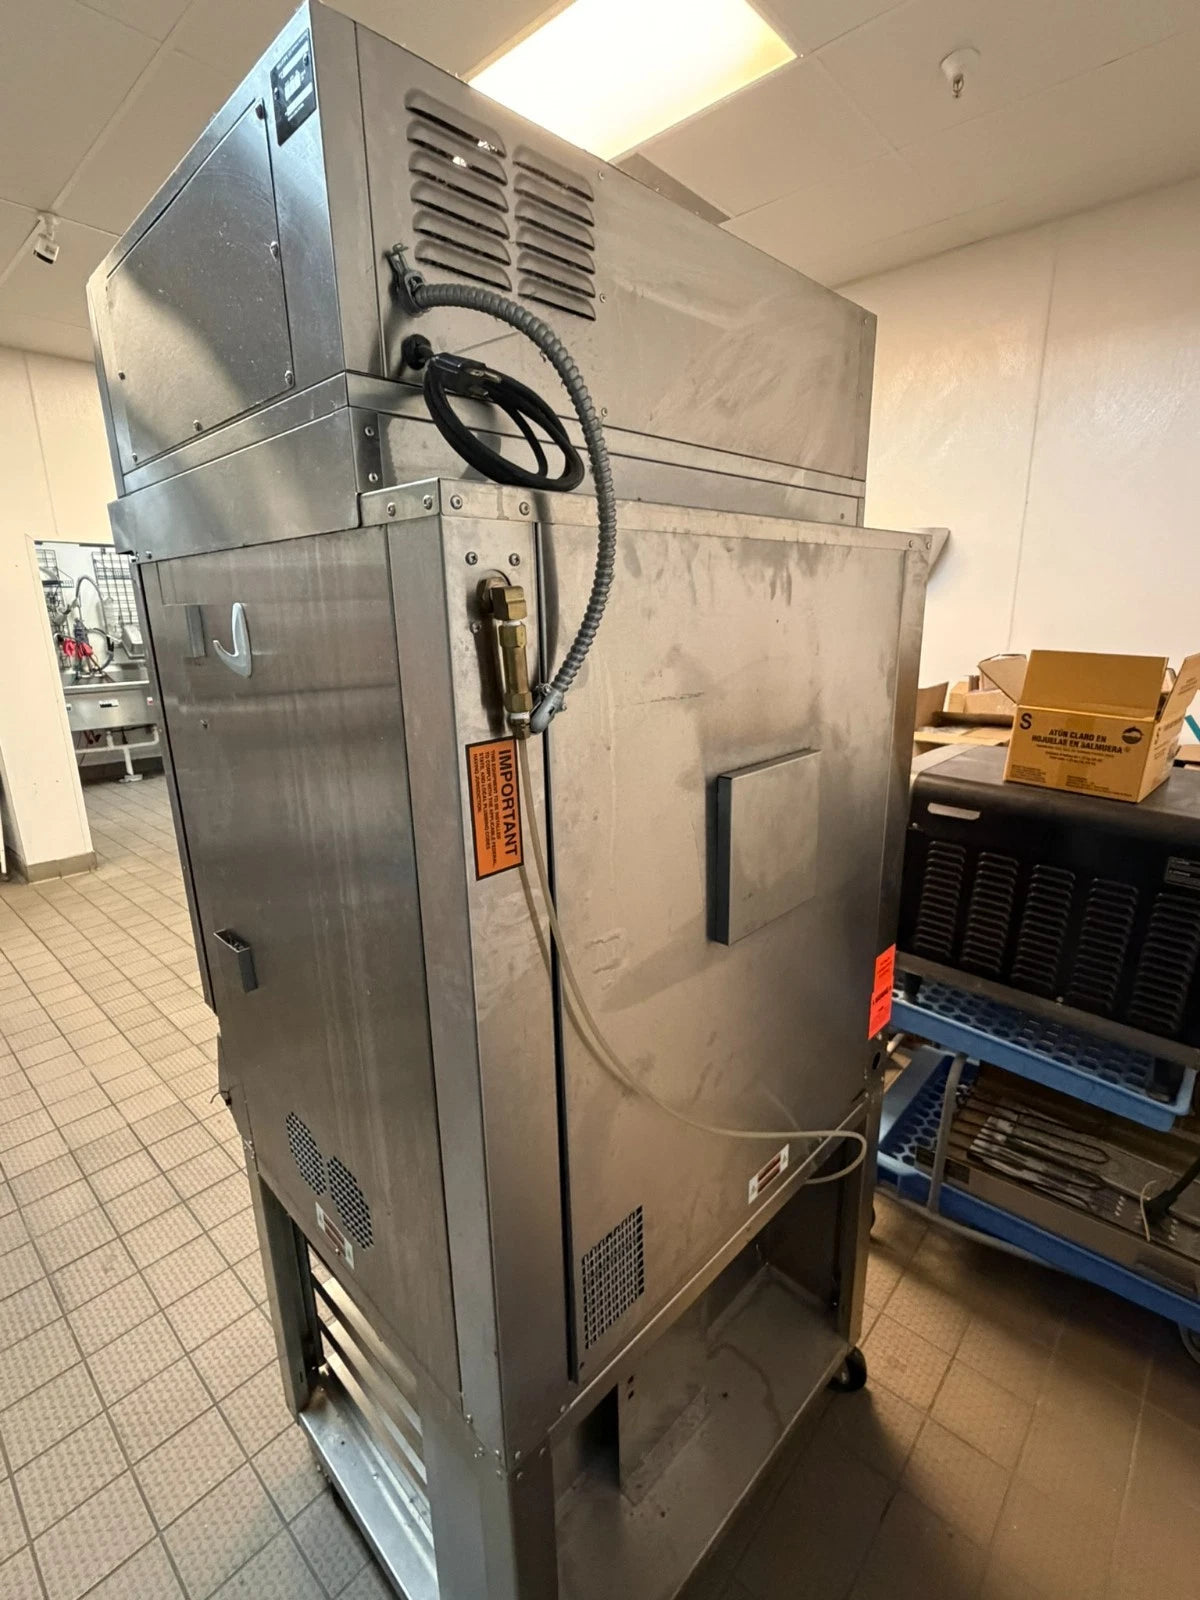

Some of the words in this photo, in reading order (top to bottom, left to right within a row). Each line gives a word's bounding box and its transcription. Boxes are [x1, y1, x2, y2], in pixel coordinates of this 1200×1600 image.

[1020, 712, 1032, 730] S
[1032, 735, 1068, 746] HOJUELAS
[1069, 739, 1079, 748] EN
[1080, 741, 1122, 754] SALMUERA
[1069, 731, 1095, 741] CLARO
[1096, 734, 1107, 743] EN
[499, 749, 518, 856] IMPORTANT
